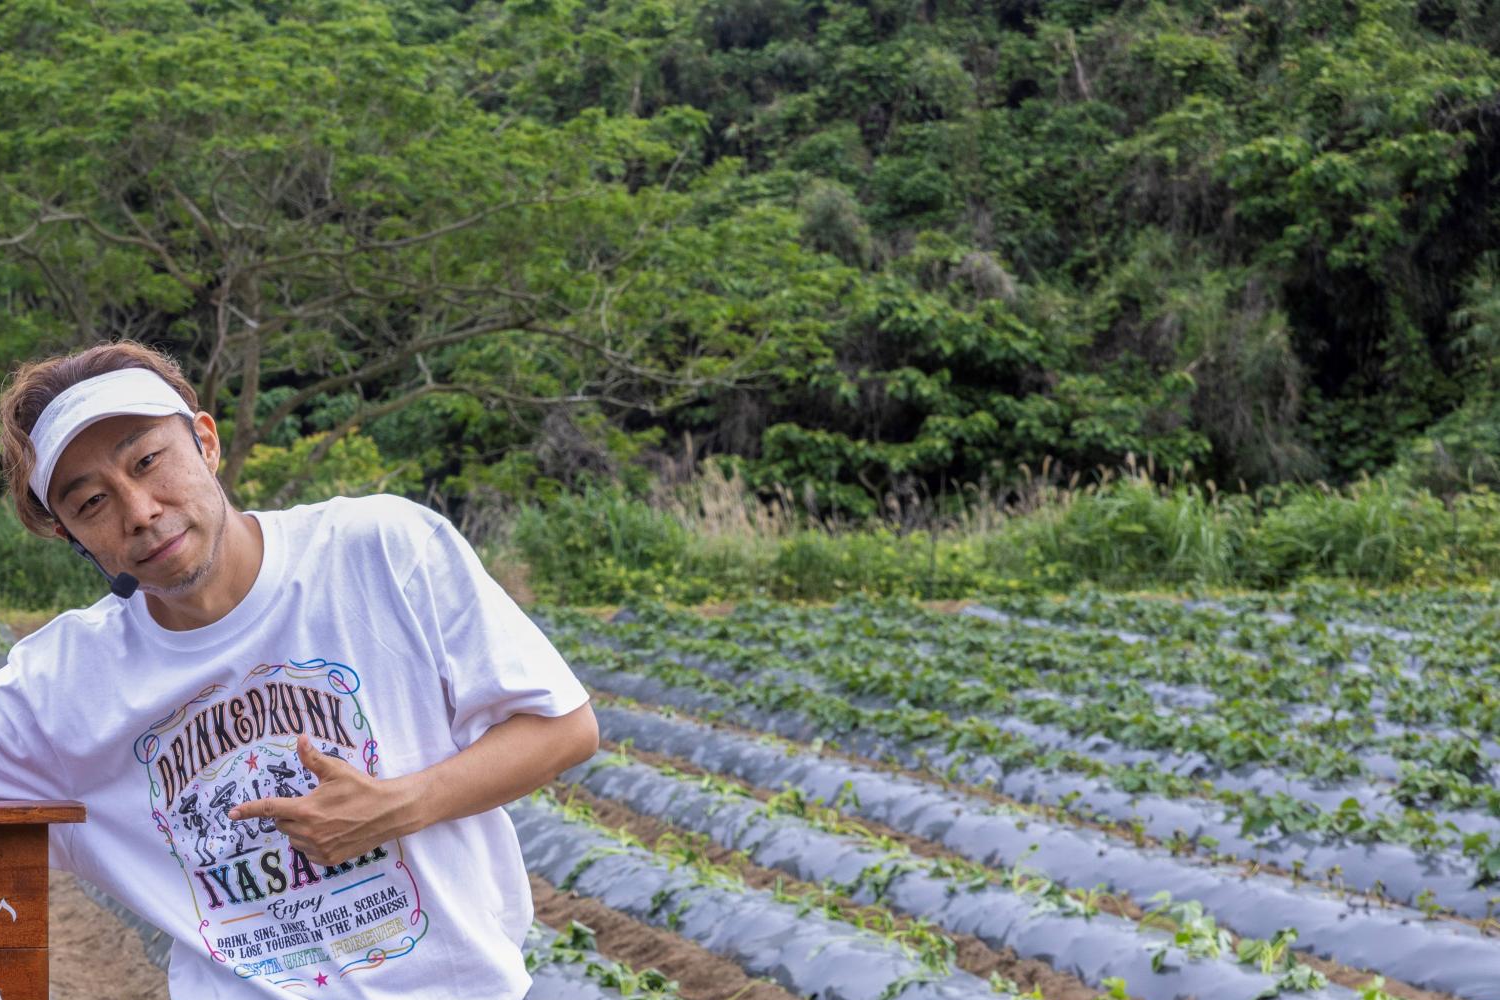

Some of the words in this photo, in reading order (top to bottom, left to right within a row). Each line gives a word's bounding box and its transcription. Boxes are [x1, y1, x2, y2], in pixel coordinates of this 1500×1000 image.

[194, 845, 389, 910] IYASA
[217, 933, 252, 948] DRINK,
[253, 925, 280, 942] SING,
[280, 920, 310, 935] DANCE,
[312, 905, 353, 928] LAUGH,
[240, 943, 263, 959] LOSE
[310, 928, 324, 943] IN
[326, 918, 352, 937] THE
[355, 894, 409, 928] MADNESS!
[266, 895, 325, 920] Enjoy
[330, 916, 408, 959] FOREVER
